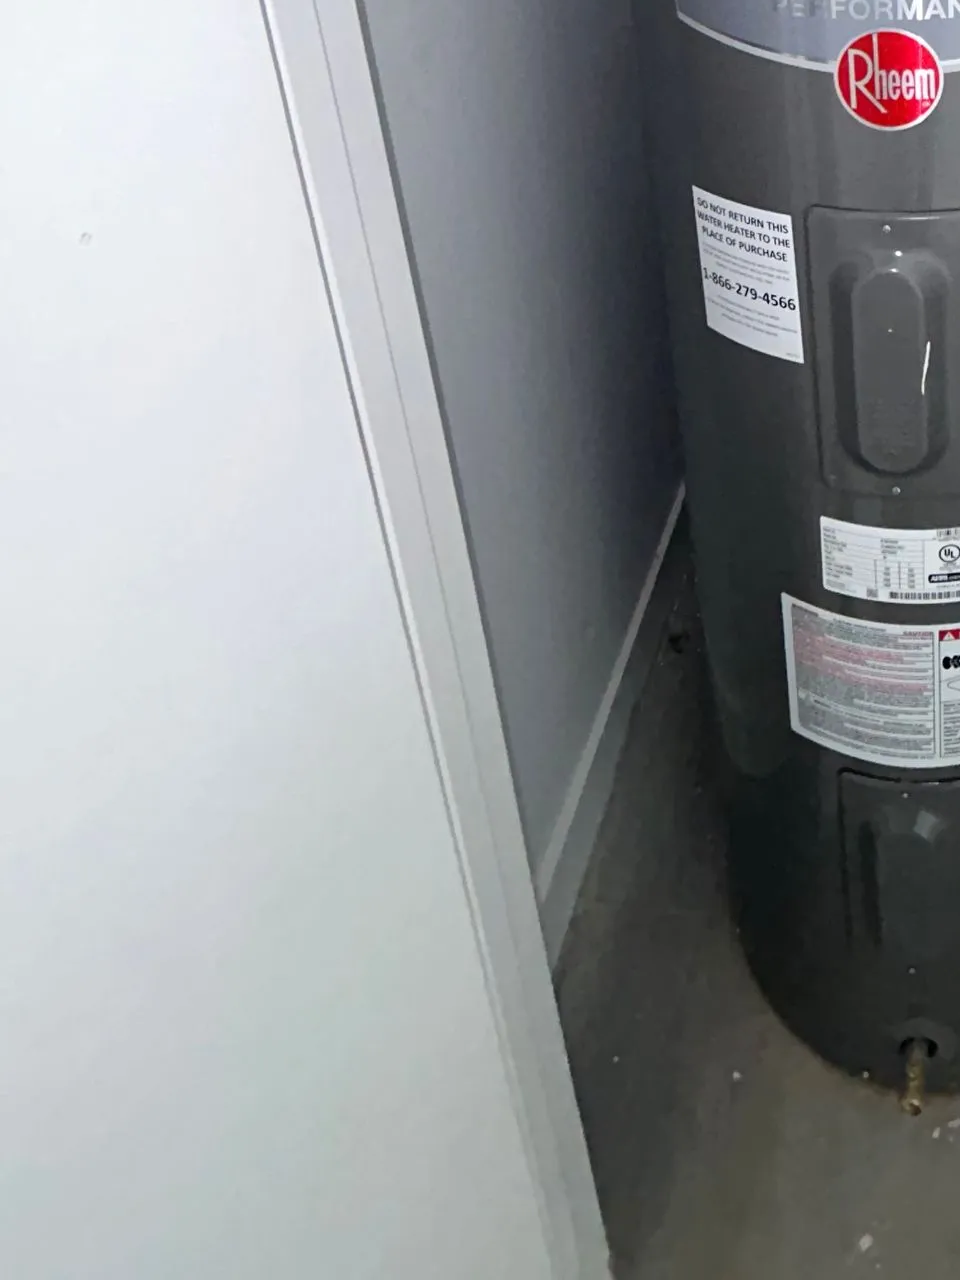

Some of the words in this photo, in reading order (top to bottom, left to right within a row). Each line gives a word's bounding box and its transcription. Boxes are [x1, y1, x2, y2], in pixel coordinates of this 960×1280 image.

[848, 33, 936, 114] Rheem
[697, 197, 709, 209] DO
[710, 203, 726, 217] NOT
[728, 210, 764, 229] RETURN
[766, 221, 789, 234] THIS
[697, 210, 723, 228] WATER
[724, 222, 756, 240] HEATER
[757, 232, 771, 244] TO
[772, 236, 791, 249] THE
[701, 225, 724, 243] PLACE
[725, 236, 736, 247] OF
[738, 241, 787, 262] PURCHASE
[703, 268, 796, 310] 1-866-279-4566
